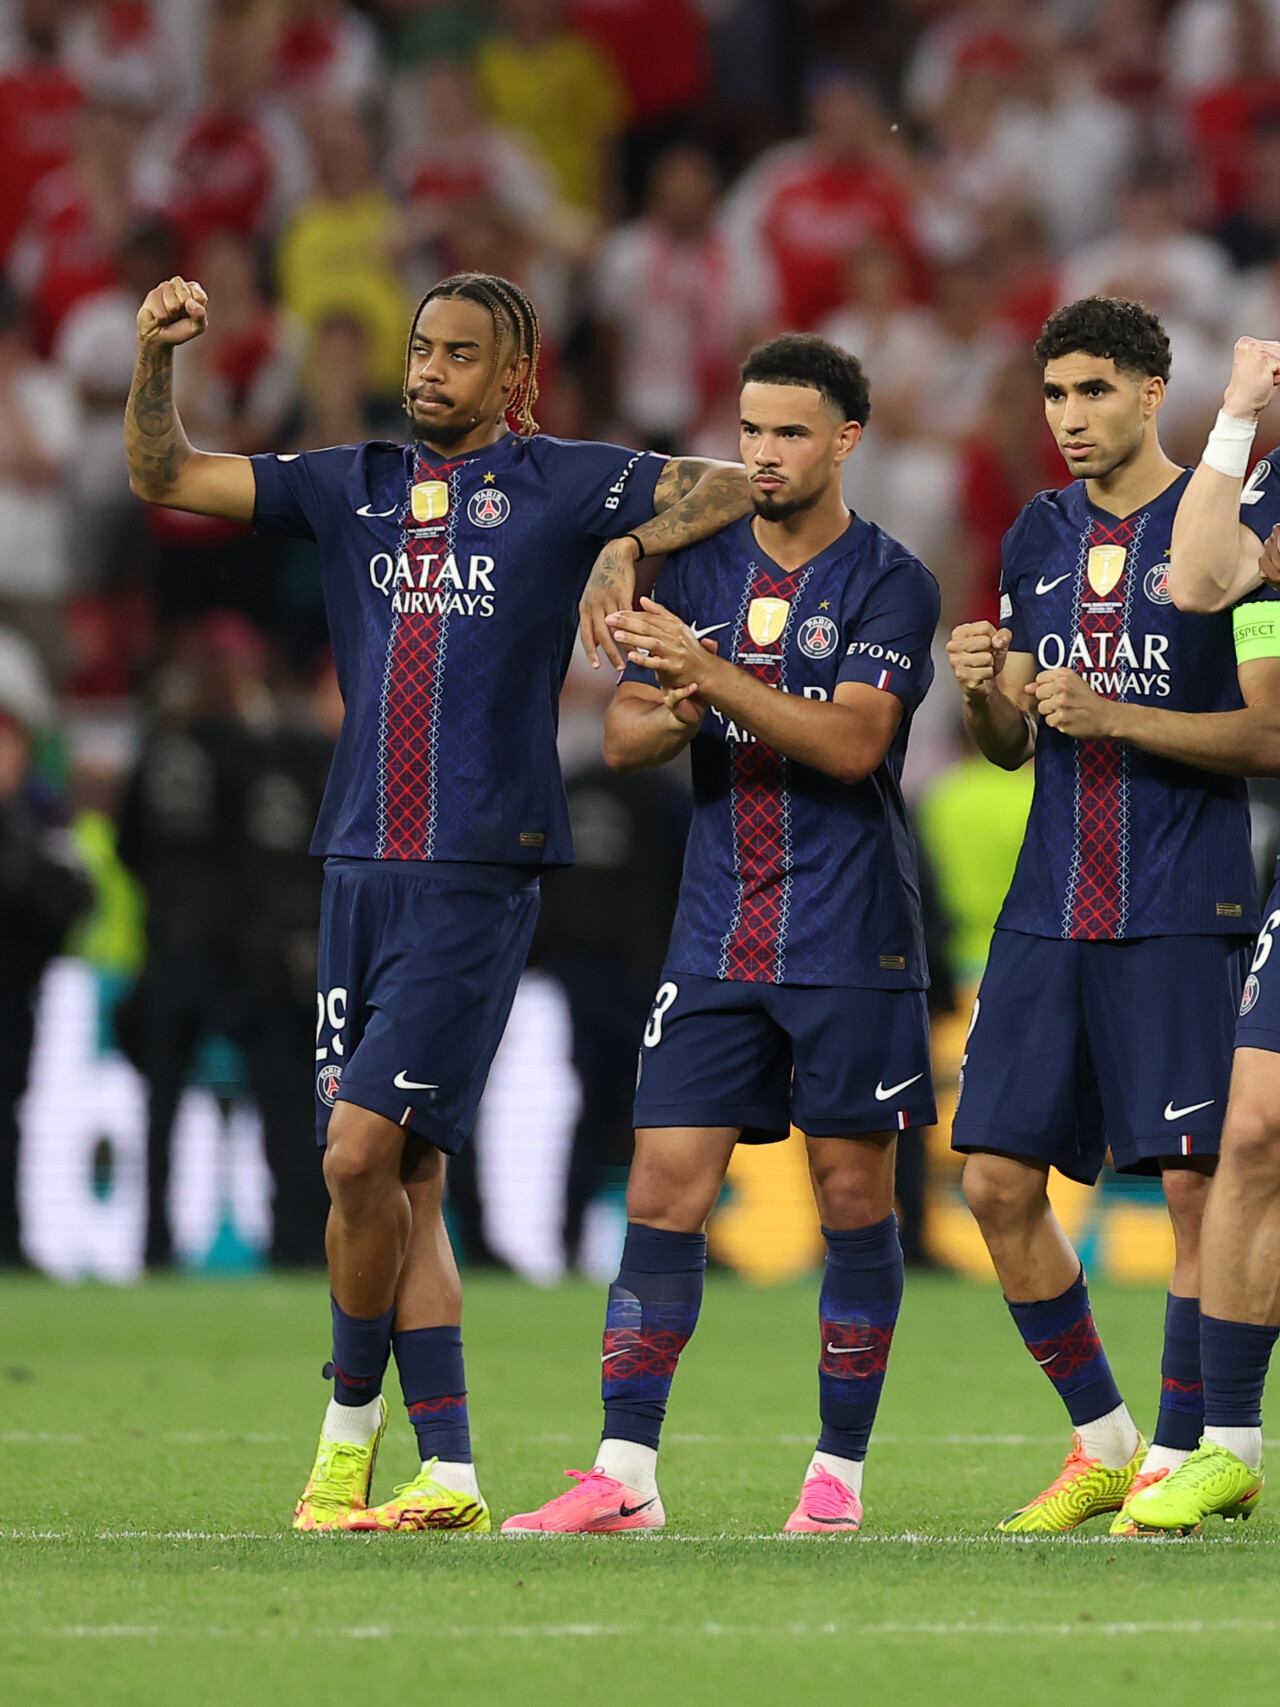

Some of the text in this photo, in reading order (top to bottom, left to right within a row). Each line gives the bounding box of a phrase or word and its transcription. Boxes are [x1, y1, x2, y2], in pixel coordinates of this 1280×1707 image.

[474, 490, 503, 502] PARIS
[369, 552, 497, 597] QATAR
[391, 591, 495, 617] AIRWAYS
[806, 618, 834, 631] PARIS
[1235, 624, 1276, 642] ESPECT
[846, 642, 912, 670] EYOND
[1038, 632, 1171, 671] QATAR
[1082, 671, 1171, 697] RWAYS
